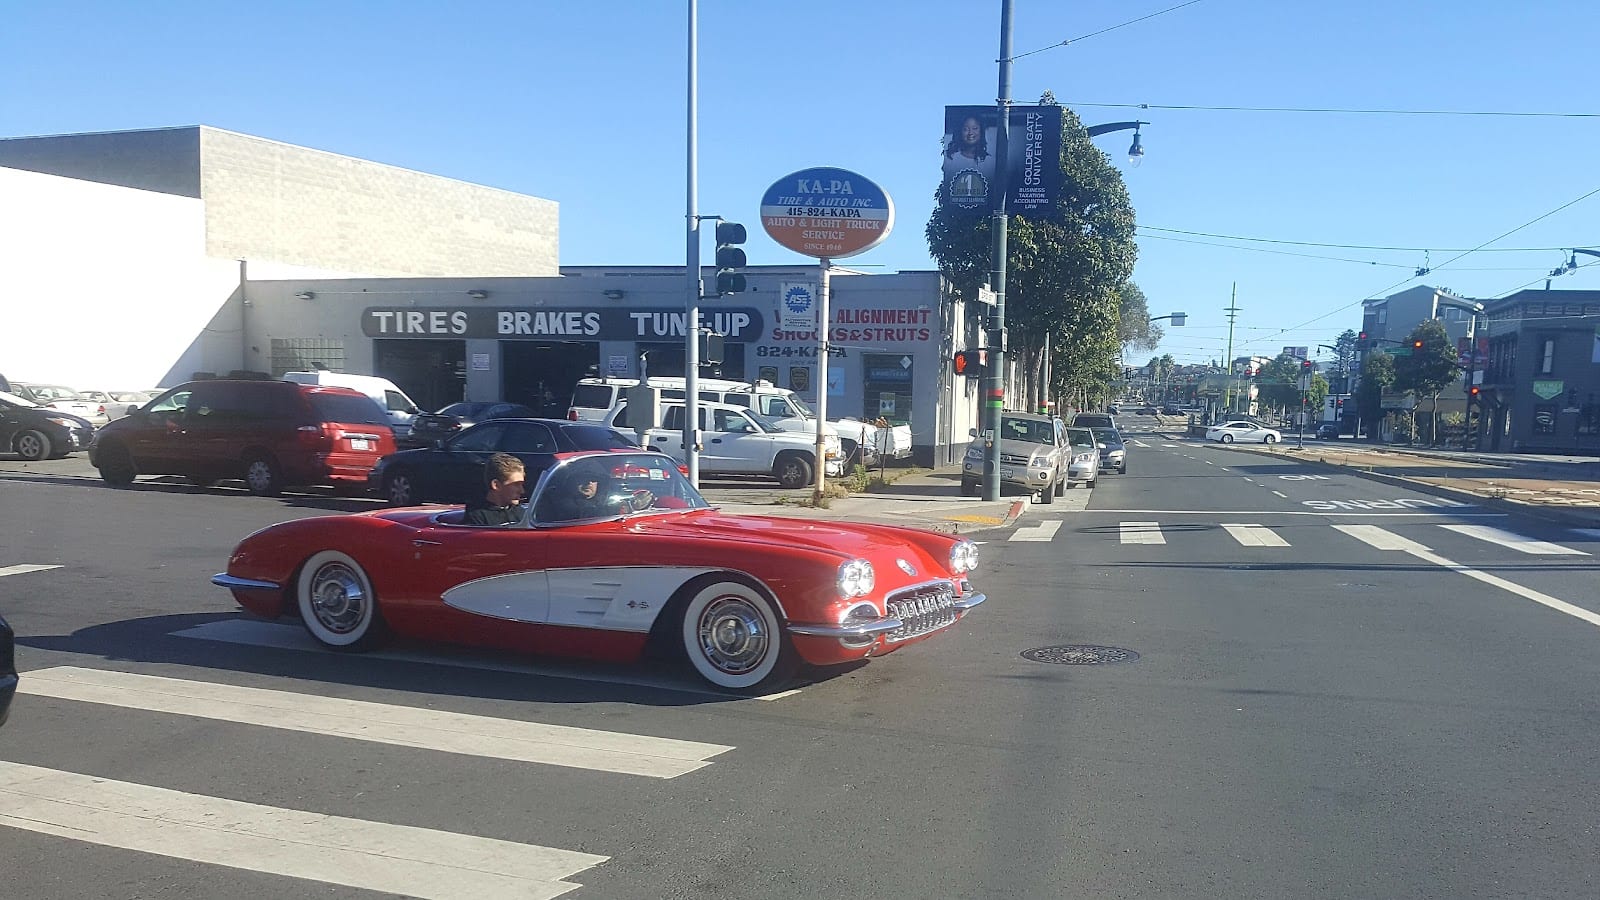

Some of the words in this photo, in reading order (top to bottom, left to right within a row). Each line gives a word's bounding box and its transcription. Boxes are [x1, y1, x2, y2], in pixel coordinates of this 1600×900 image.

[1026, 112, 1035, 141] GATE
[1032, 112, 1043, 185] UNIVERSITY
[1024, 143, 1034, 185] GOLDEN
[797, 179, 854, 195] KA-PA
[777, 196, 804, 205] TIRE
[804, 197, 813, 206] &
[818, 198, 849, 207] AUTO
[852, 198, 873, 207] INC.
[786, 207, 861, 218] 415-824-KAPA
[767, 218, 796, 227] AUTO
[798, 219, 807, 227] &
[811, 219, 842, 229] LIGHT
[846, 220, 880, 230] TRUCK
[801, 230, 846, 240] SERVICE
[803, 242, 826, 250] SINCE
[371, 311, 468, 334] TIRES
[497, 311, 600, 336] BRAKES
[836, 309, 932, 324] ALIGNMENT
